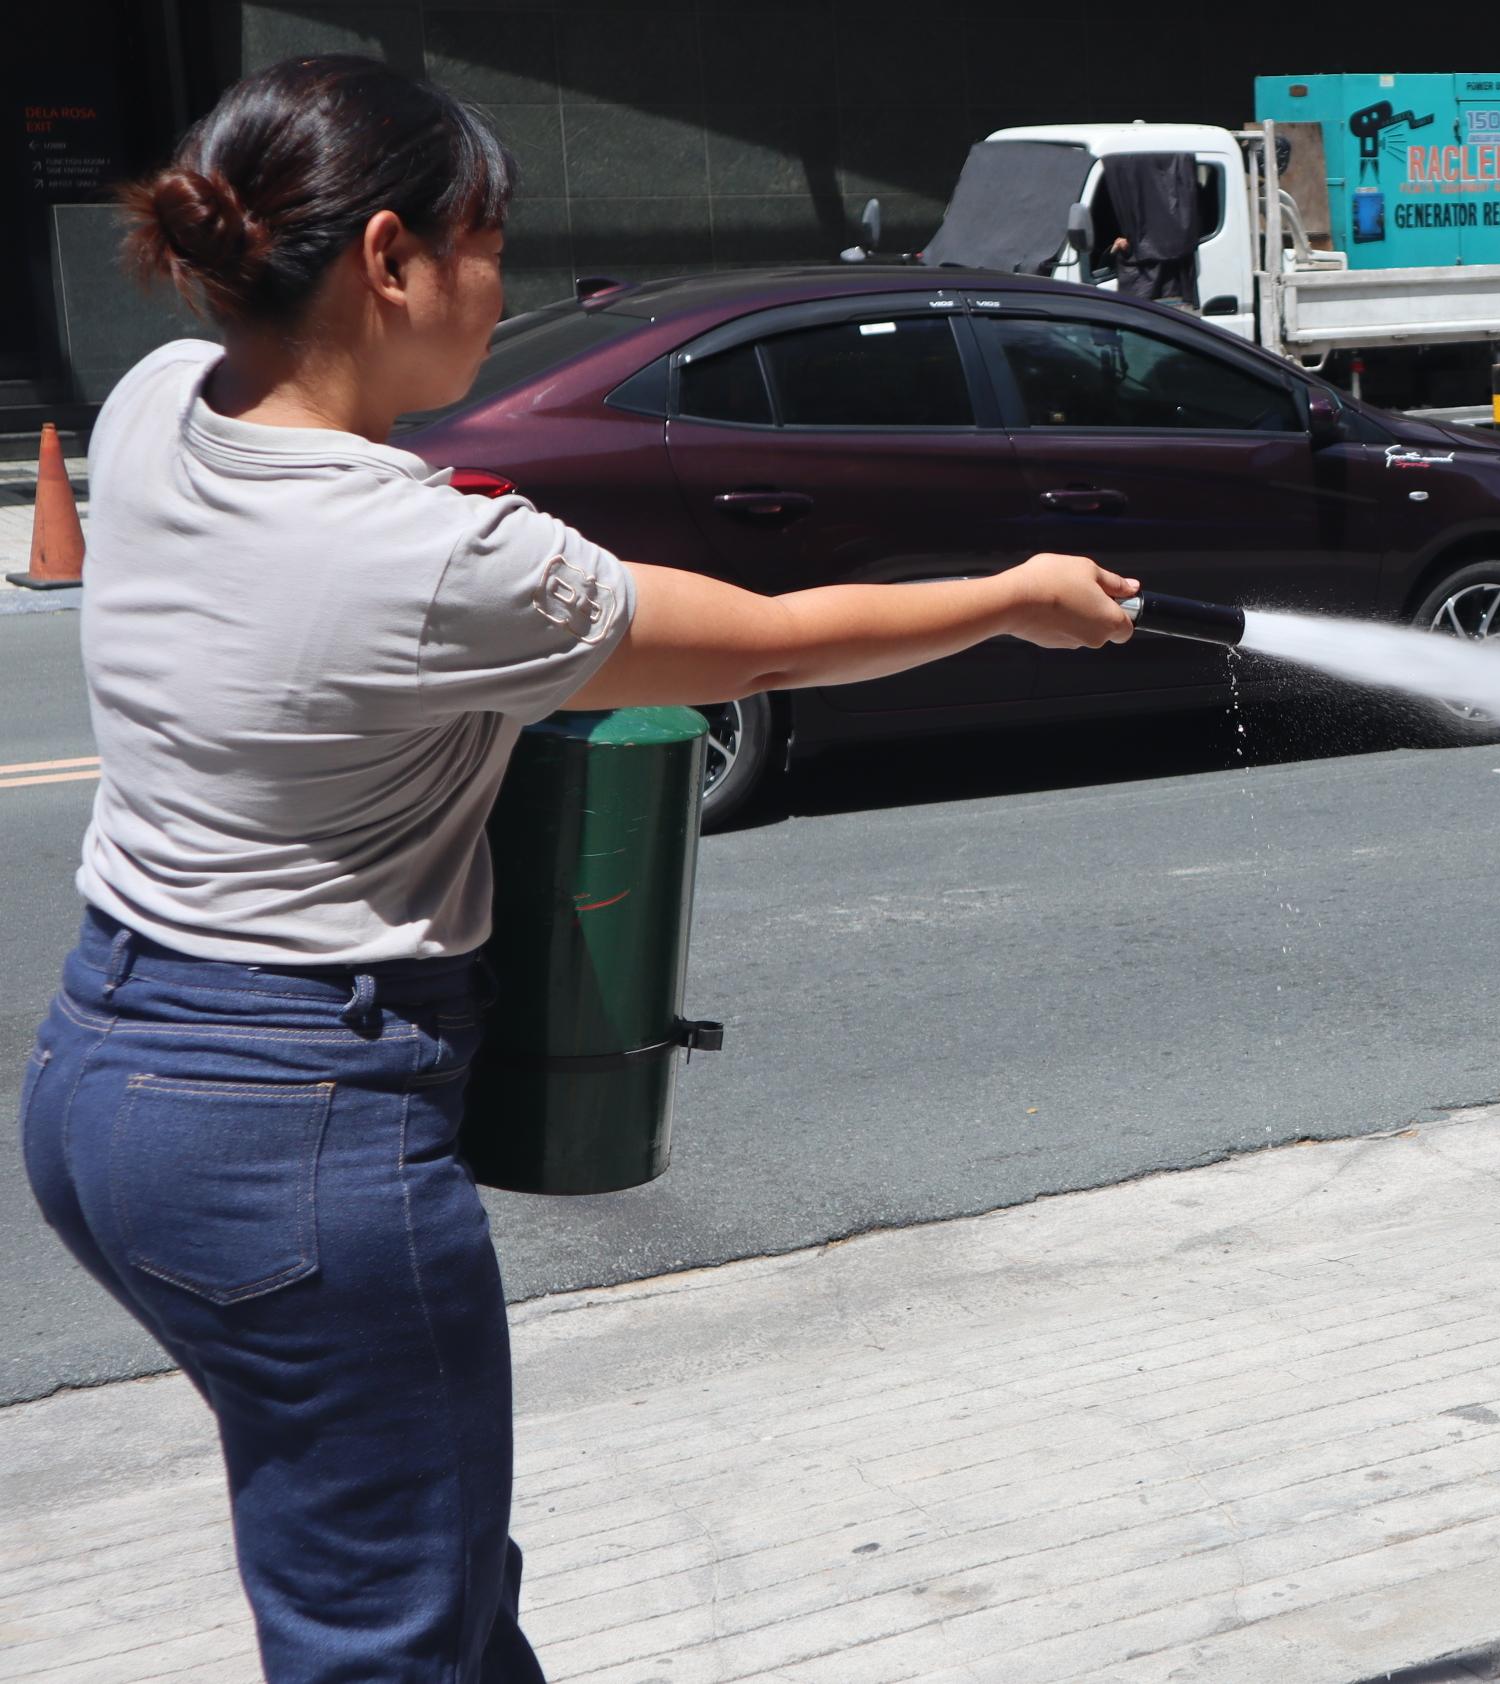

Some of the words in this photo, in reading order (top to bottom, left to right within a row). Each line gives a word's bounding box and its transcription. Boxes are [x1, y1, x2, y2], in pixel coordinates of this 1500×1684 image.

[61, 106, 96, 119] ROSA
[25, 120, 52, 133] EXIT
[1395, 202, 1477, 229] GENERATOR
[929, 300, 954, 308] VIOS
[976, 300, 1000, 308] VIOS
